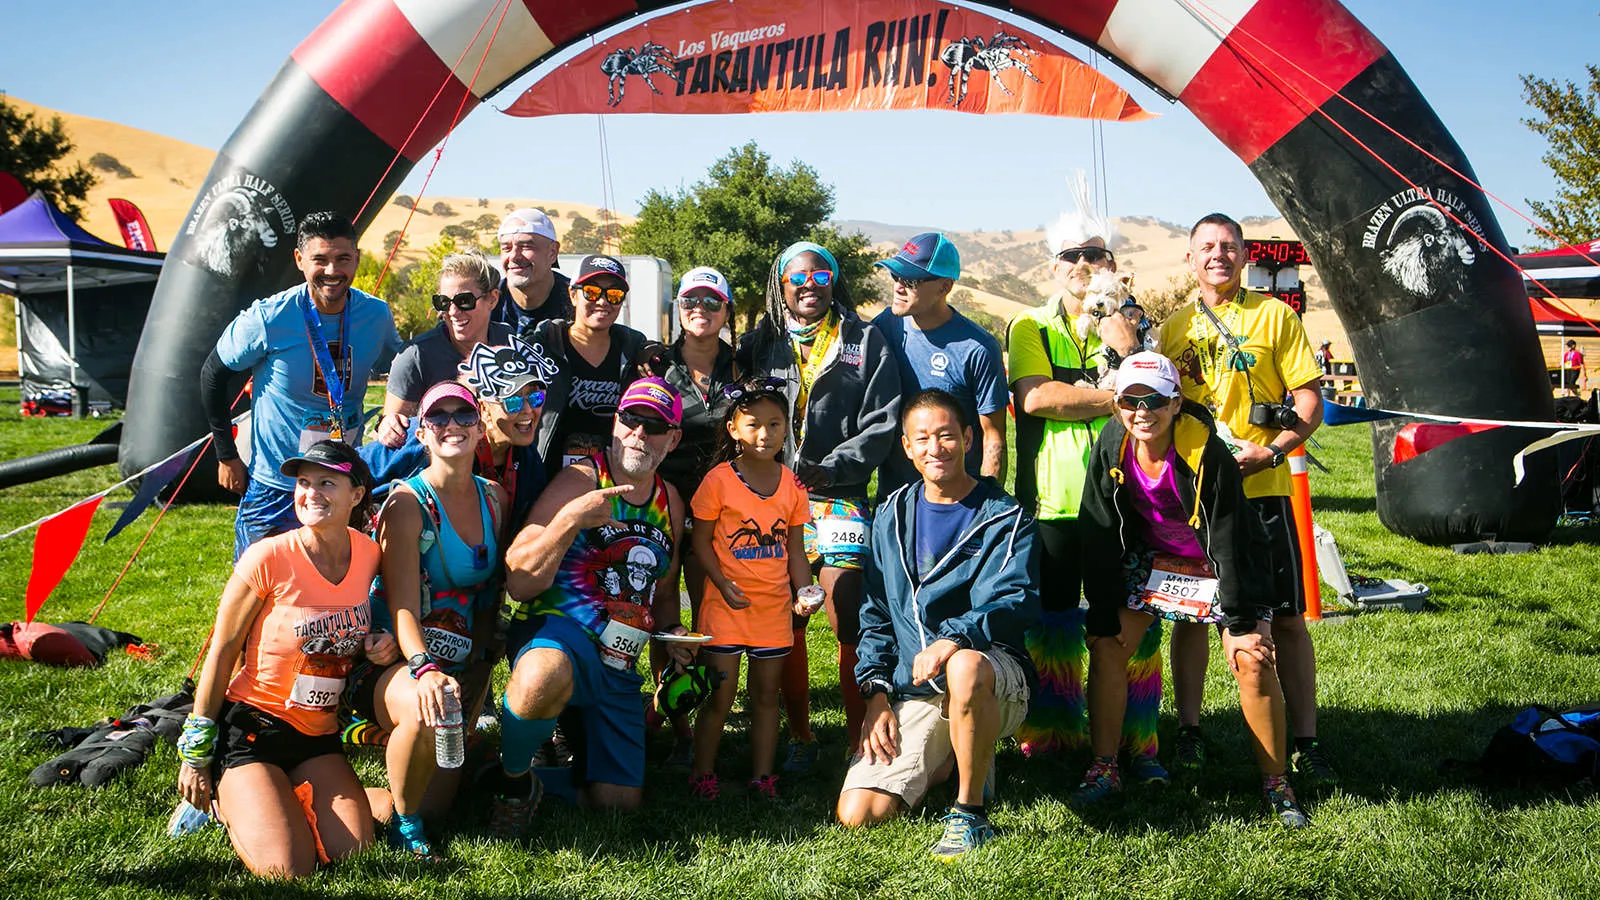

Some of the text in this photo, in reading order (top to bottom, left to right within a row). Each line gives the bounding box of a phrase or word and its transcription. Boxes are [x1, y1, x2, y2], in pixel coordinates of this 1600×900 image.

[677, 21, 786, 58] Los Vaqueros
[675, 9, 949, 97] TARANTULA RUN!
[244, 174, 275, 196] HALF
[271, 192, 297, 234] SERIES
[1362, 202, 1394, 249] BRAZEN
[1391, 186, 1432, 208] ULTRA
[1436, 188, 1466, 212] HALF
[569, 389, 620, 410] Racin
[633, 523, 647, 534] or
[651, 527, 671, 551] Die
[831, 531, 865, 545] 2486
[1161, 582, 1201, 599] 3507
[1165, 574, 1201, 587] MARIA
[294, 609, 352, 638] TARANTULA
[423, 627, 470, 650] MEGATRON
[612, 635, 640, 656] 3564
[306, 690, 337, 705] 3597
